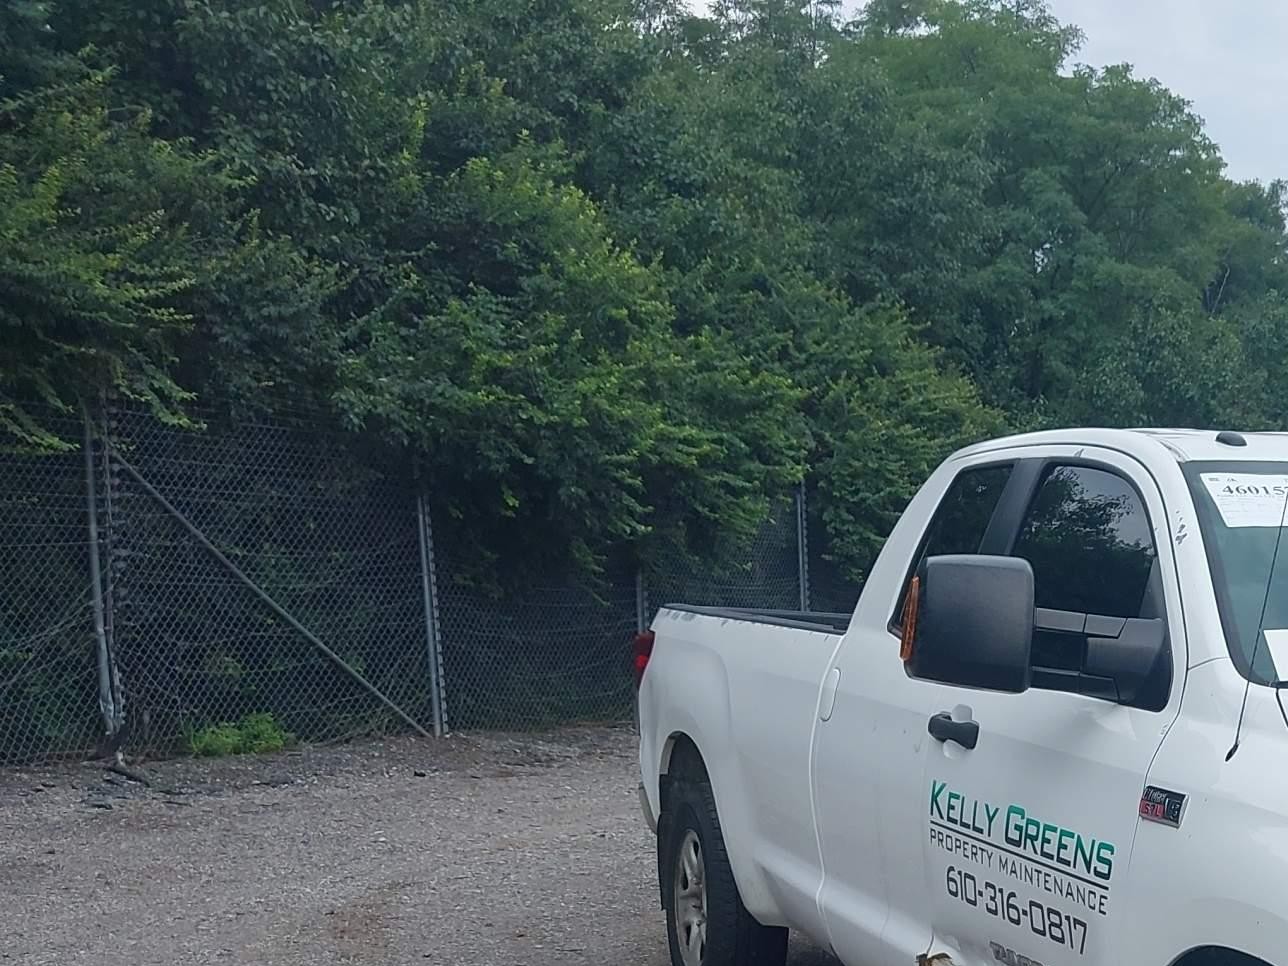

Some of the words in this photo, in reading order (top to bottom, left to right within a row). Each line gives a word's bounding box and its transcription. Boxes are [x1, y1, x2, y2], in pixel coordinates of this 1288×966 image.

[929, 779, 999, 838] KELLY
[1004, 804, 1115, 882] GREENS
[929, 828, 994, 869] PROPERTY
[998, 855, 1109, 916] MAINTENANCE
[946, 865, 1089, 956] 610-316-0817
